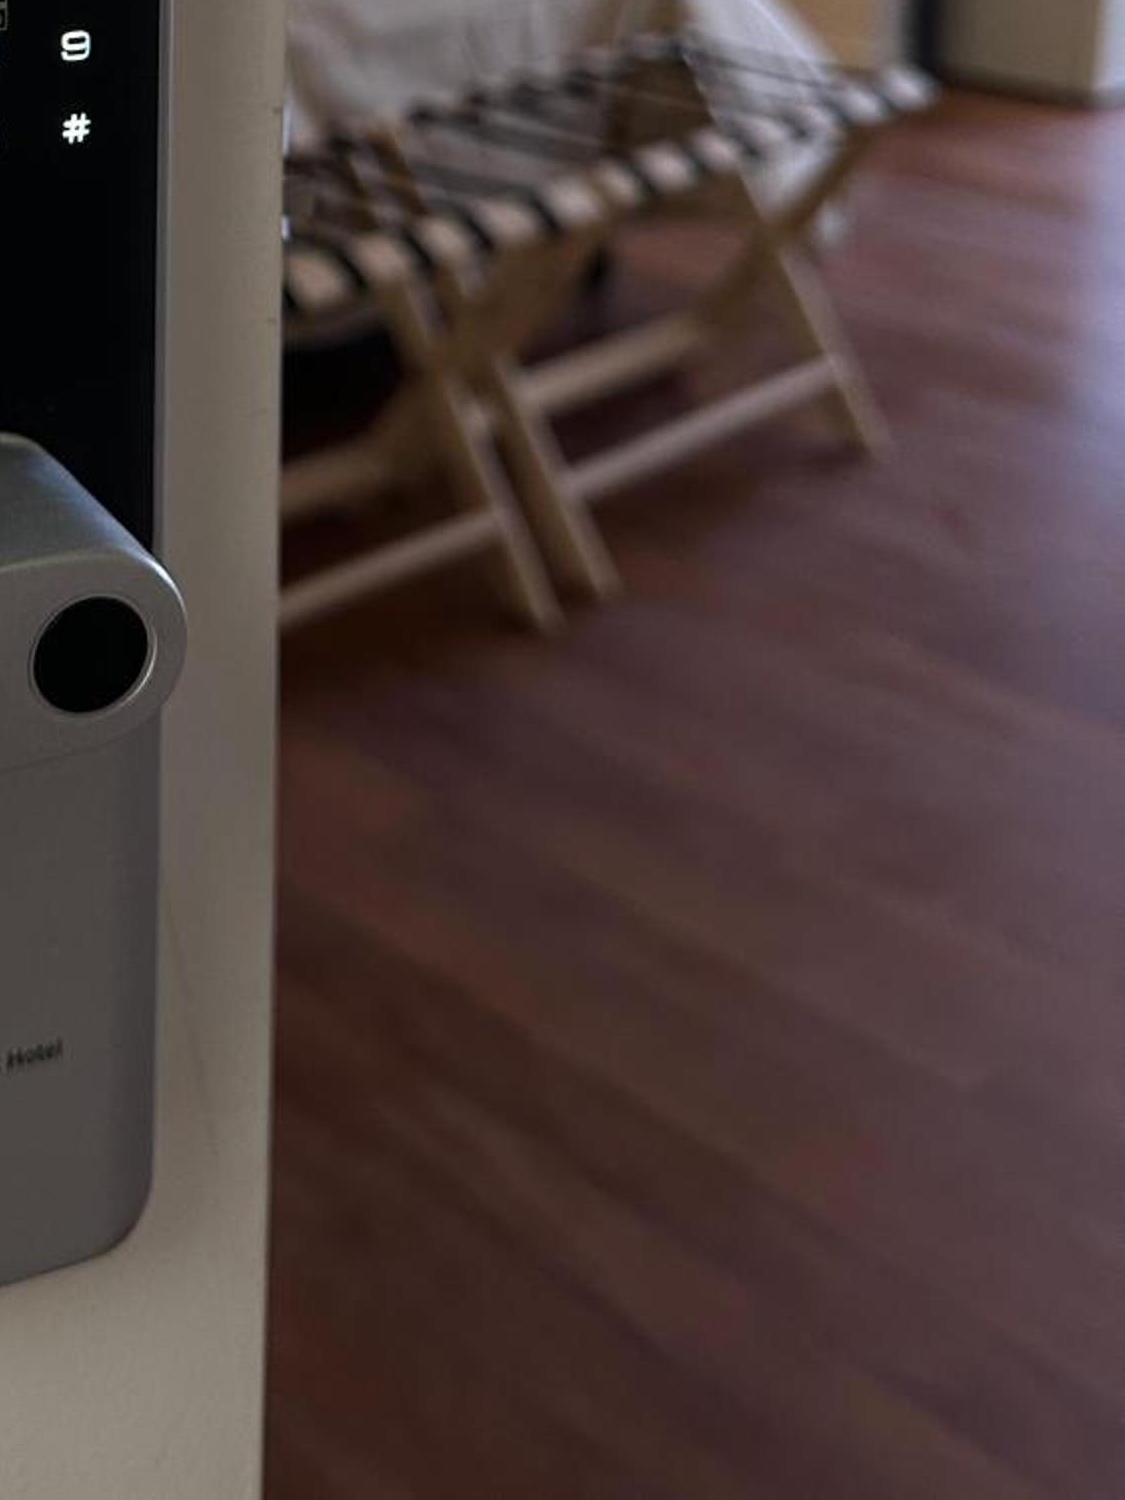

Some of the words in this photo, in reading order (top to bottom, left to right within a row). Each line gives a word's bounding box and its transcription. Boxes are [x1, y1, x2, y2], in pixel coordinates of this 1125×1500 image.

[60, 29, 91, 62] 9
[62, 112, 92, 144] #
[6, 1037, 63, 1070] Hotel
